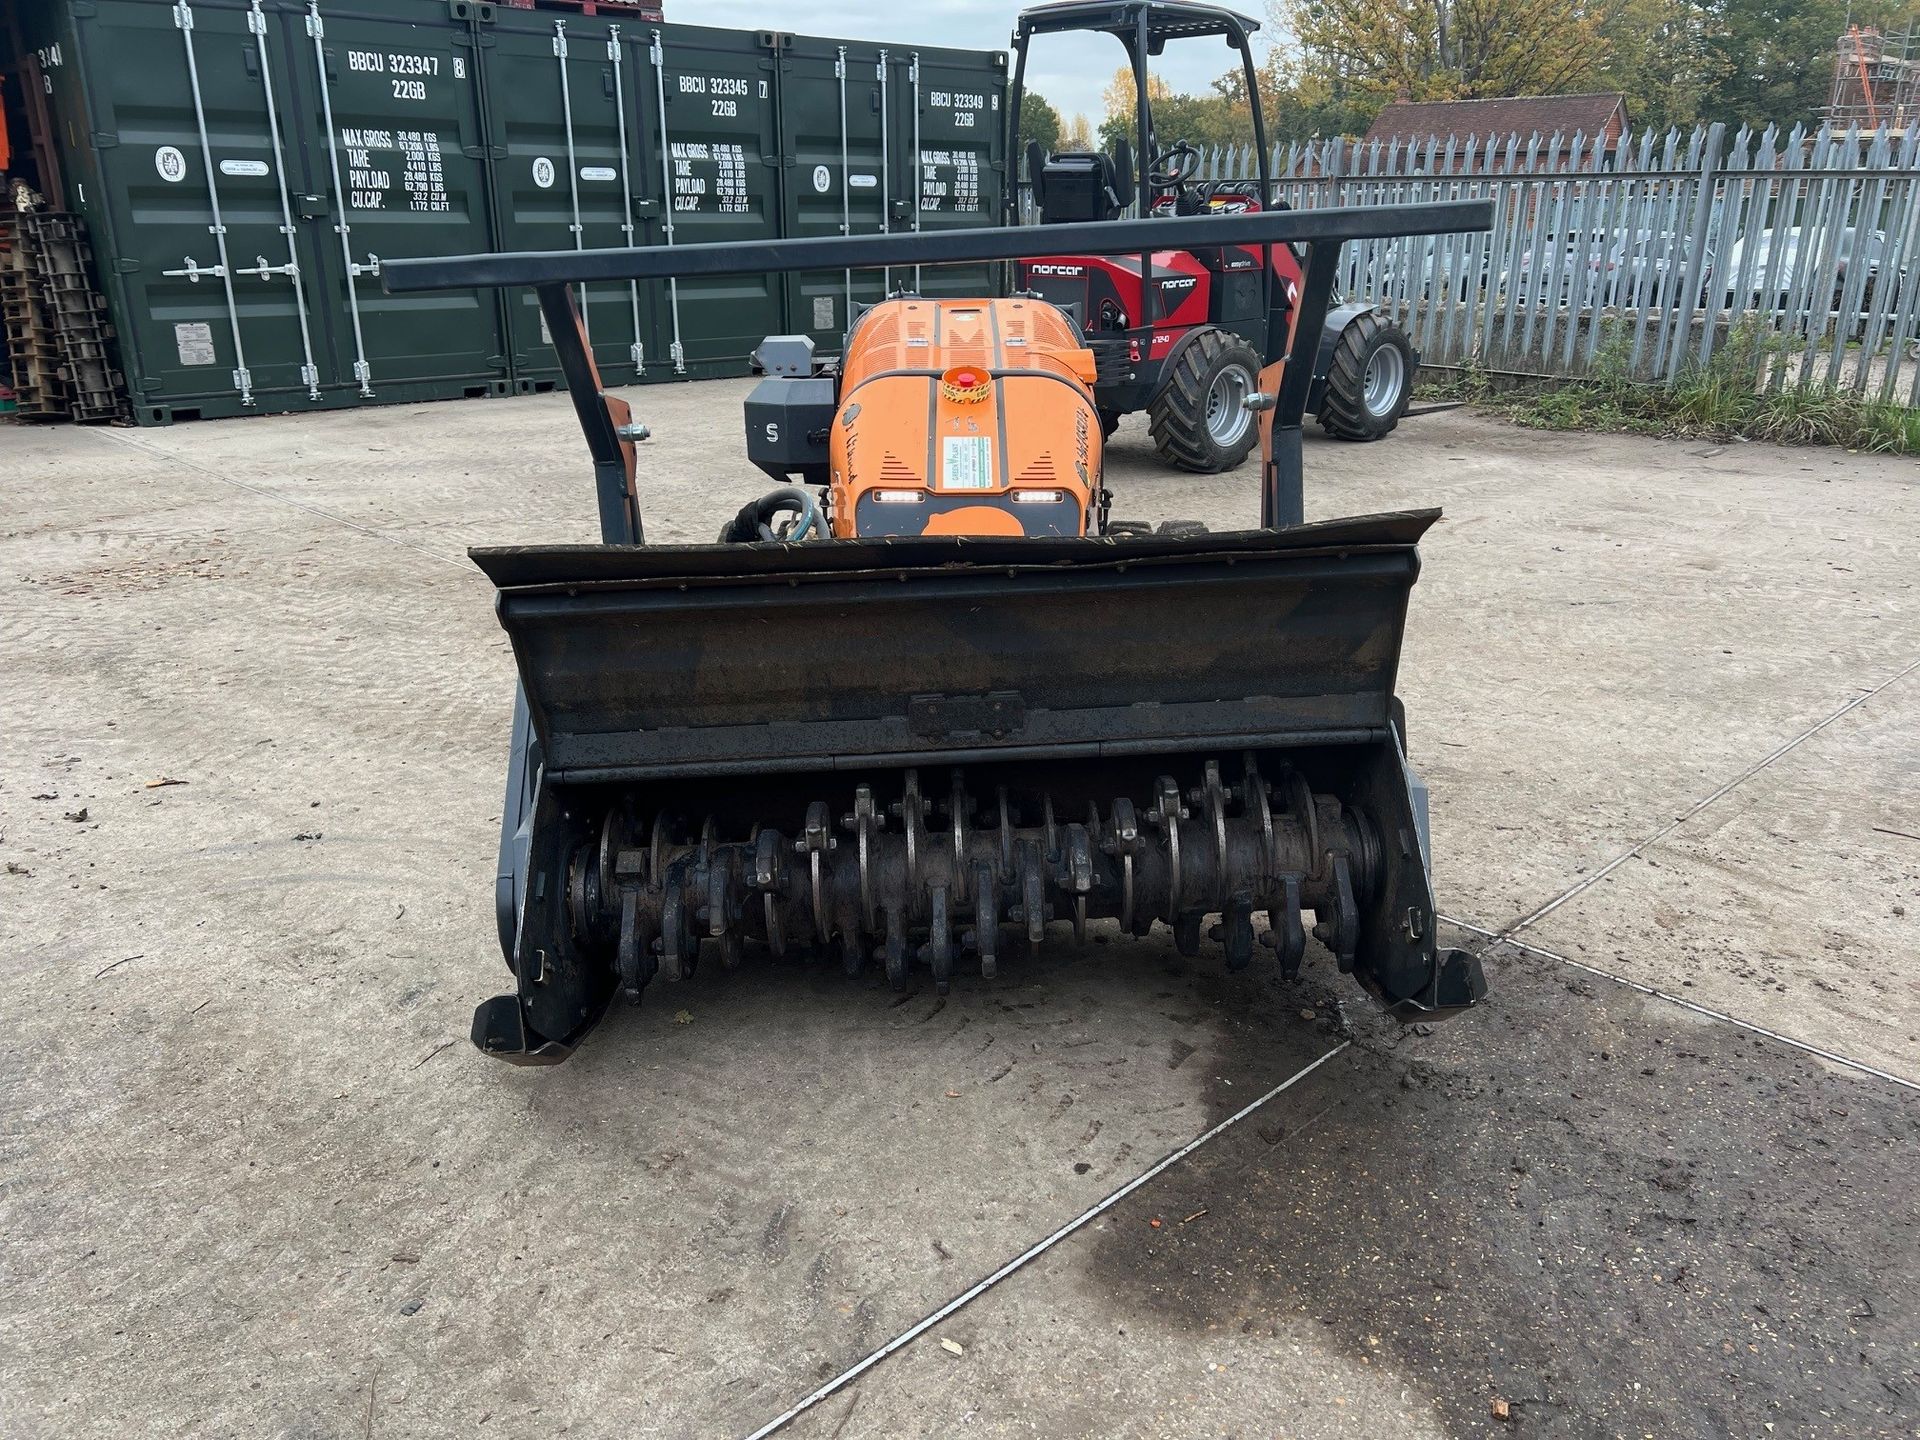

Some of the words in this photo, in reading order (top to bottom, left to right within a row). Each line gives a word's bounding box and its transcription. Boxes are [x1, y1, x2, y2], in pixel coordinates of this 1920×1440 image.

[348, 51, 384, 72] BBCU
[389, 54, 438, 75] 323347
[392, 80, 426, 100] 22GB
[680, 76, 706, 93] BBCU
[711, 78, 748, 95] 323345
[759, 81, 768, 98] 7
[931, 92, 951, 107] BBCU
[955, 93, 983, 109] 323349
[712, 100, 737, 116] 22GB
[955, 113, 974, 126] 22GB
[363, 130, 392, 148] GROSS
[424, 132, 437, 142] KGS
[425, 143, 439, 151] LBS
[687, 143, 708, 159] GROSS
[347, 149, 371, 167] TARE
[428, 152, 441, 162] KGS
[429, 162, 442, 172] LBS
[675, 160, 692, 176] TARE
[924, 166, 936, 179] TARE
[350, 171, 390, 189] PAYLOAD
[430, 173, 443, 182] KGS
[431, 183, 444, 192] LBS
[676, 178, 706, 194] PAYLOAD
[923, 182, 946, 195] PAYLOAD
[1032, 264, 1083, 276] norcar
[1161, 277, 1197, 289] norcar
